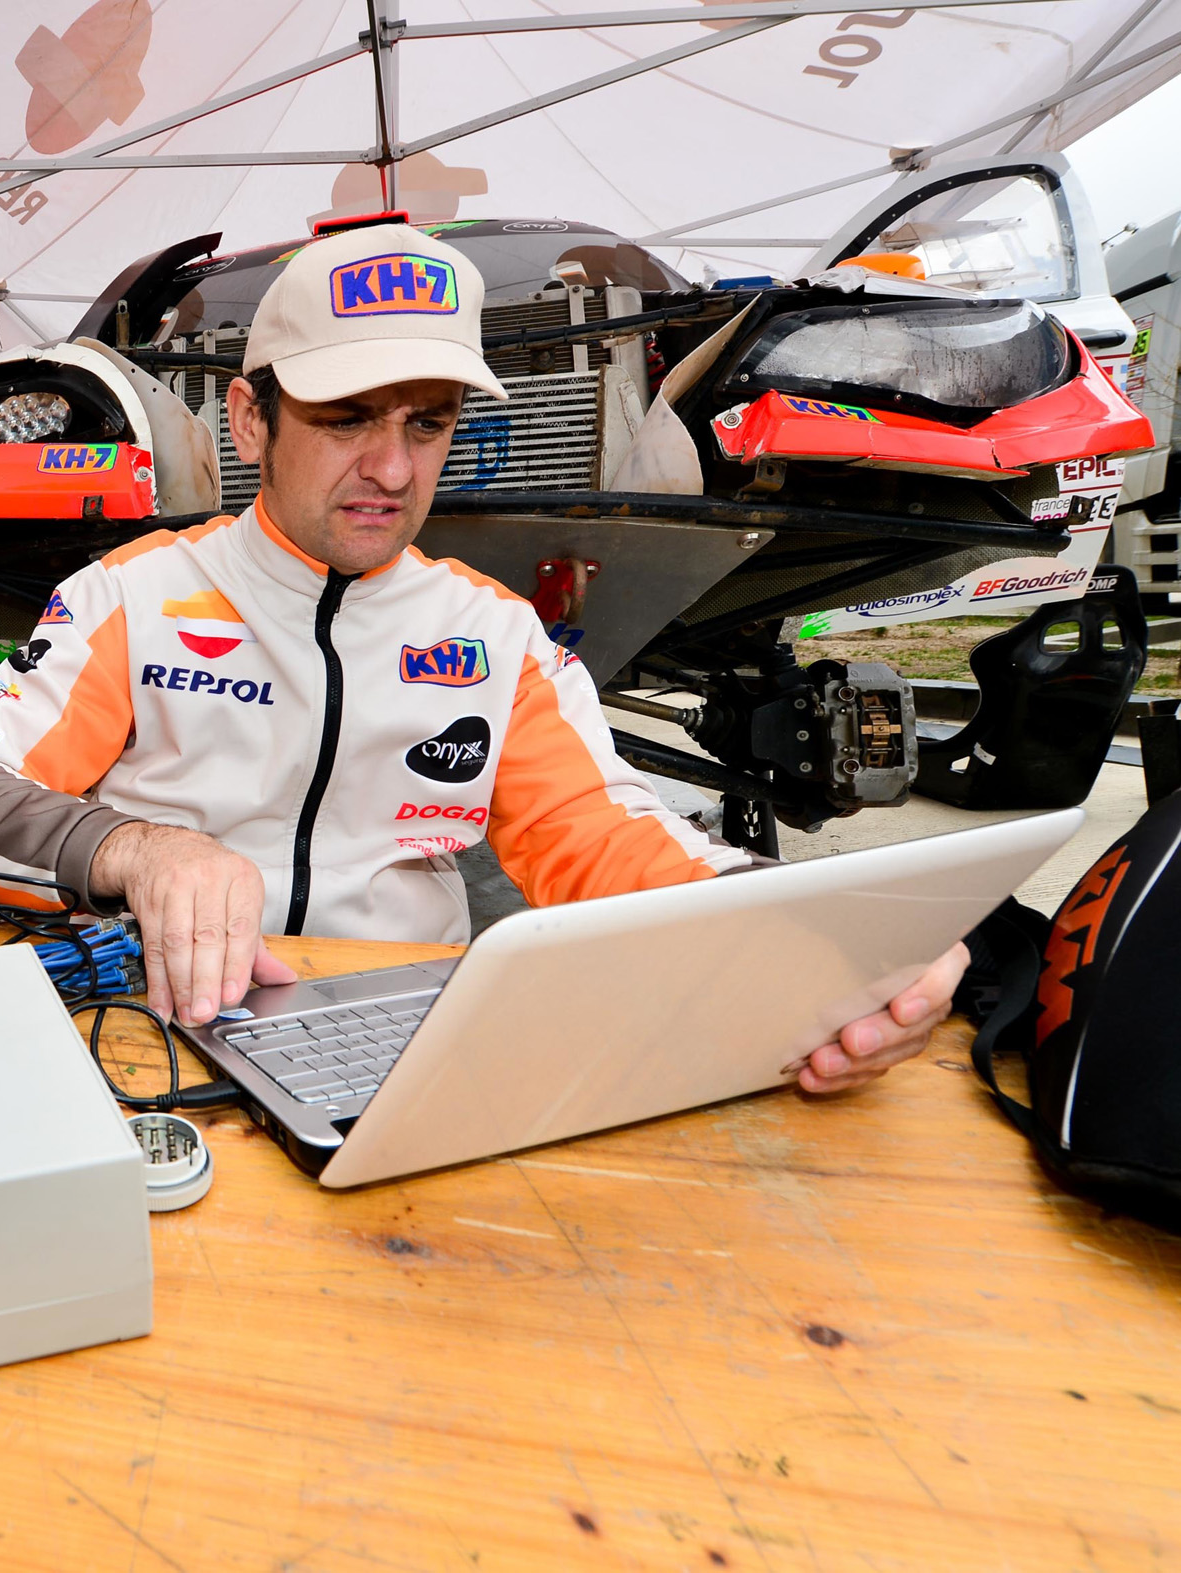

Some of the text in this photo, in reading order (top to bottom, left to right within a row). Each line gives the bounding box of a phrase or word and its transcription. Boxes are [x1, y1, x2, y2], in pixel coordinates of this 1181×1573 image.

[341, 262, 447, 310] KH-7
[787, 398, 869, 421] KH-7
[43, 447, 113, 469] KH-7
[973, 567, 1088, 596] BFGoodrich
[141, 664, 274, 705] REPSOL
[395, 802, 488, 826] DOGA
